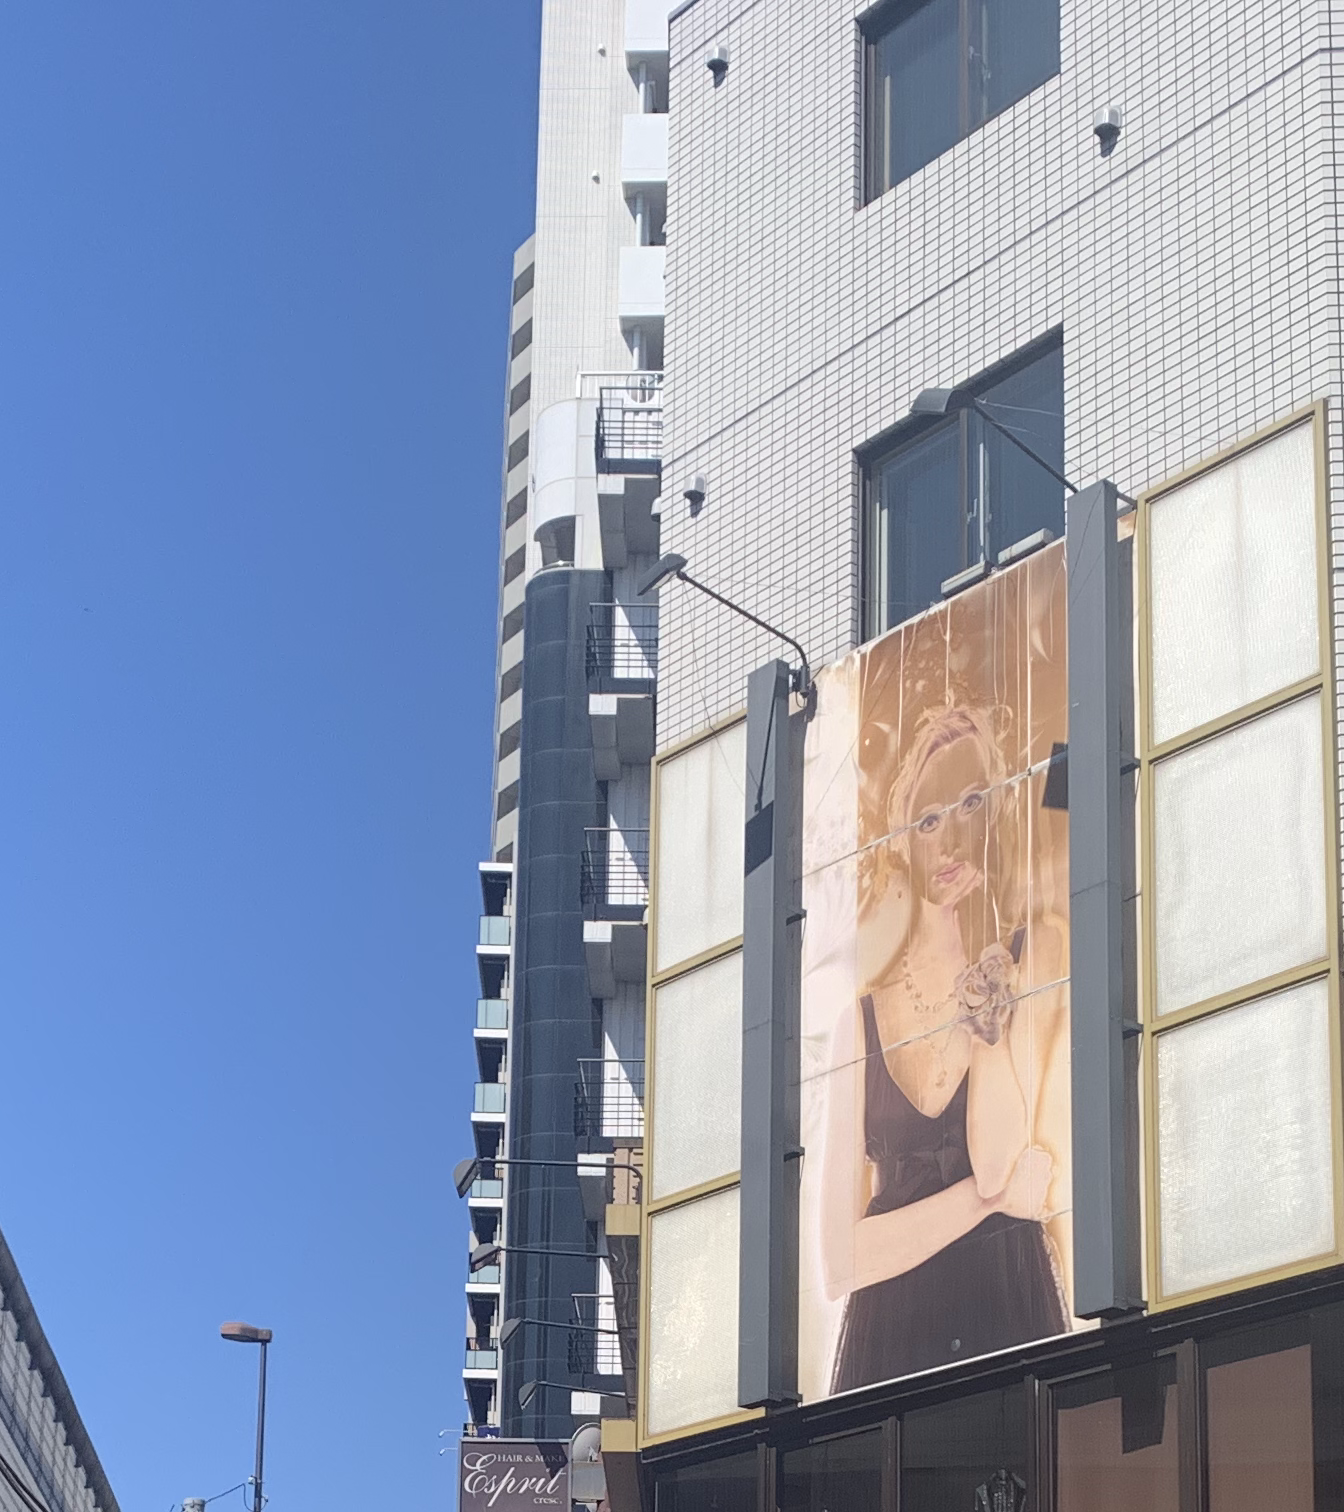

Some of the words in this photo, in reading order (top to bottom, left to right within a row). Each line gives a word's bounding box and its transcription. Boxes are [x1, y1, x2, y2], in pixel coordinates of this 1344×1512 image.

[497, 1454, 523, 1462] HAIR
[524, 1455, 533, 1463] &
[463, 1452, 567, 1507] Esprit
